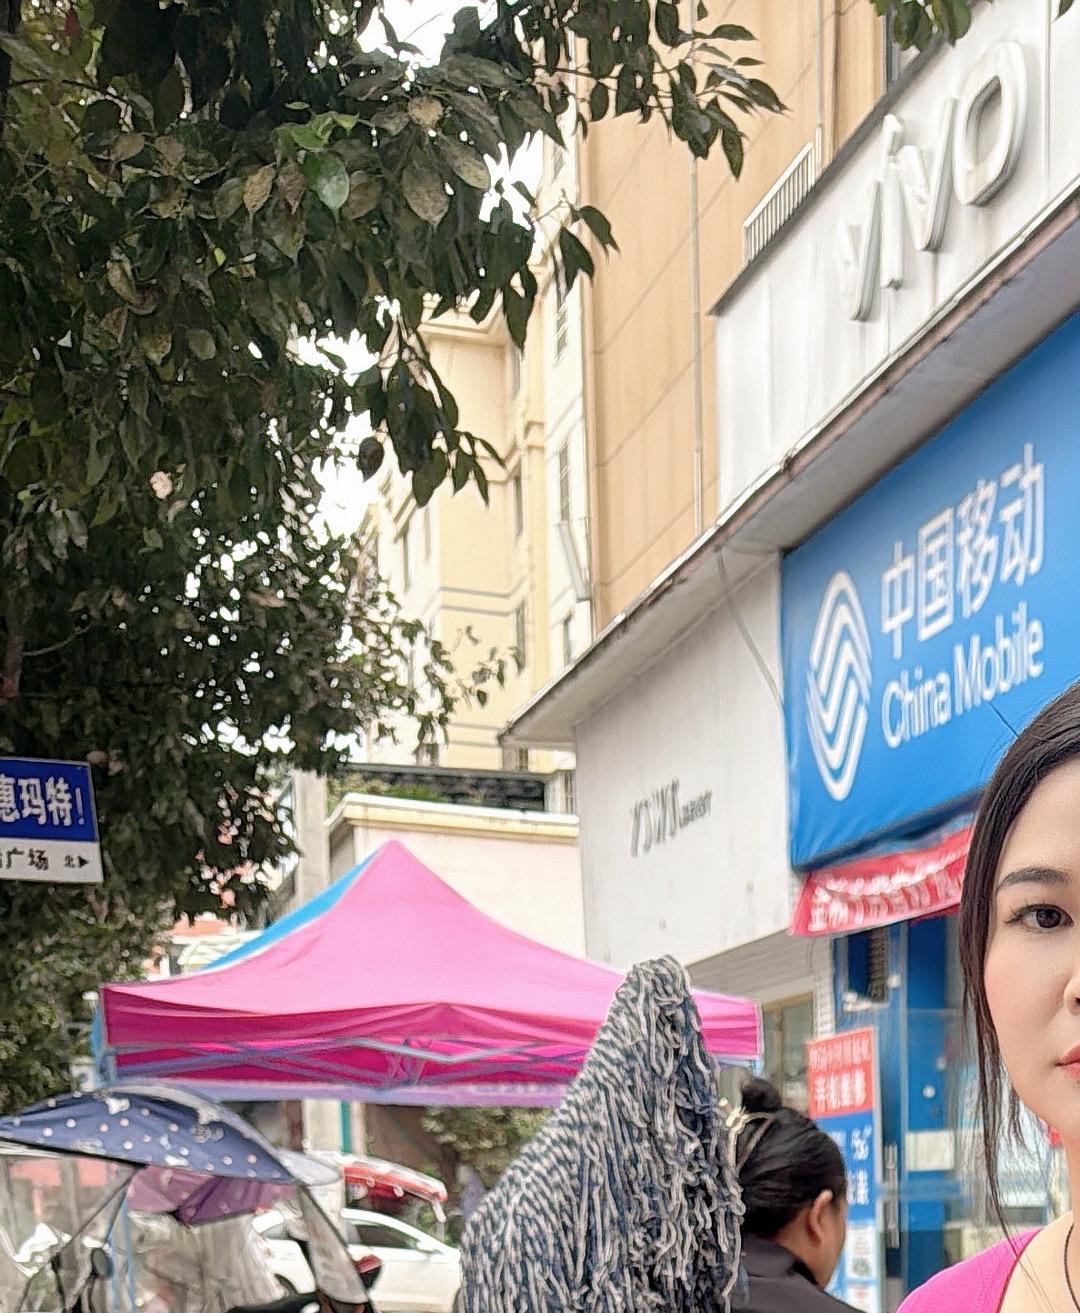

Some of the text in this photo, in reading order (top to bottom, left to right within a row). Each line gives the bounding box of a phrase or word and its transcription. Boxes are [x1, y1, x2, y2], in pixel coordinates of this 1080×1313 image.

[838, 40, 1027, 321] vivo
[881, 442, 1044, 660] 中国移动
[881, 600, 1044, 748] China Mobile
[0, 848, 49, 871] 广场
